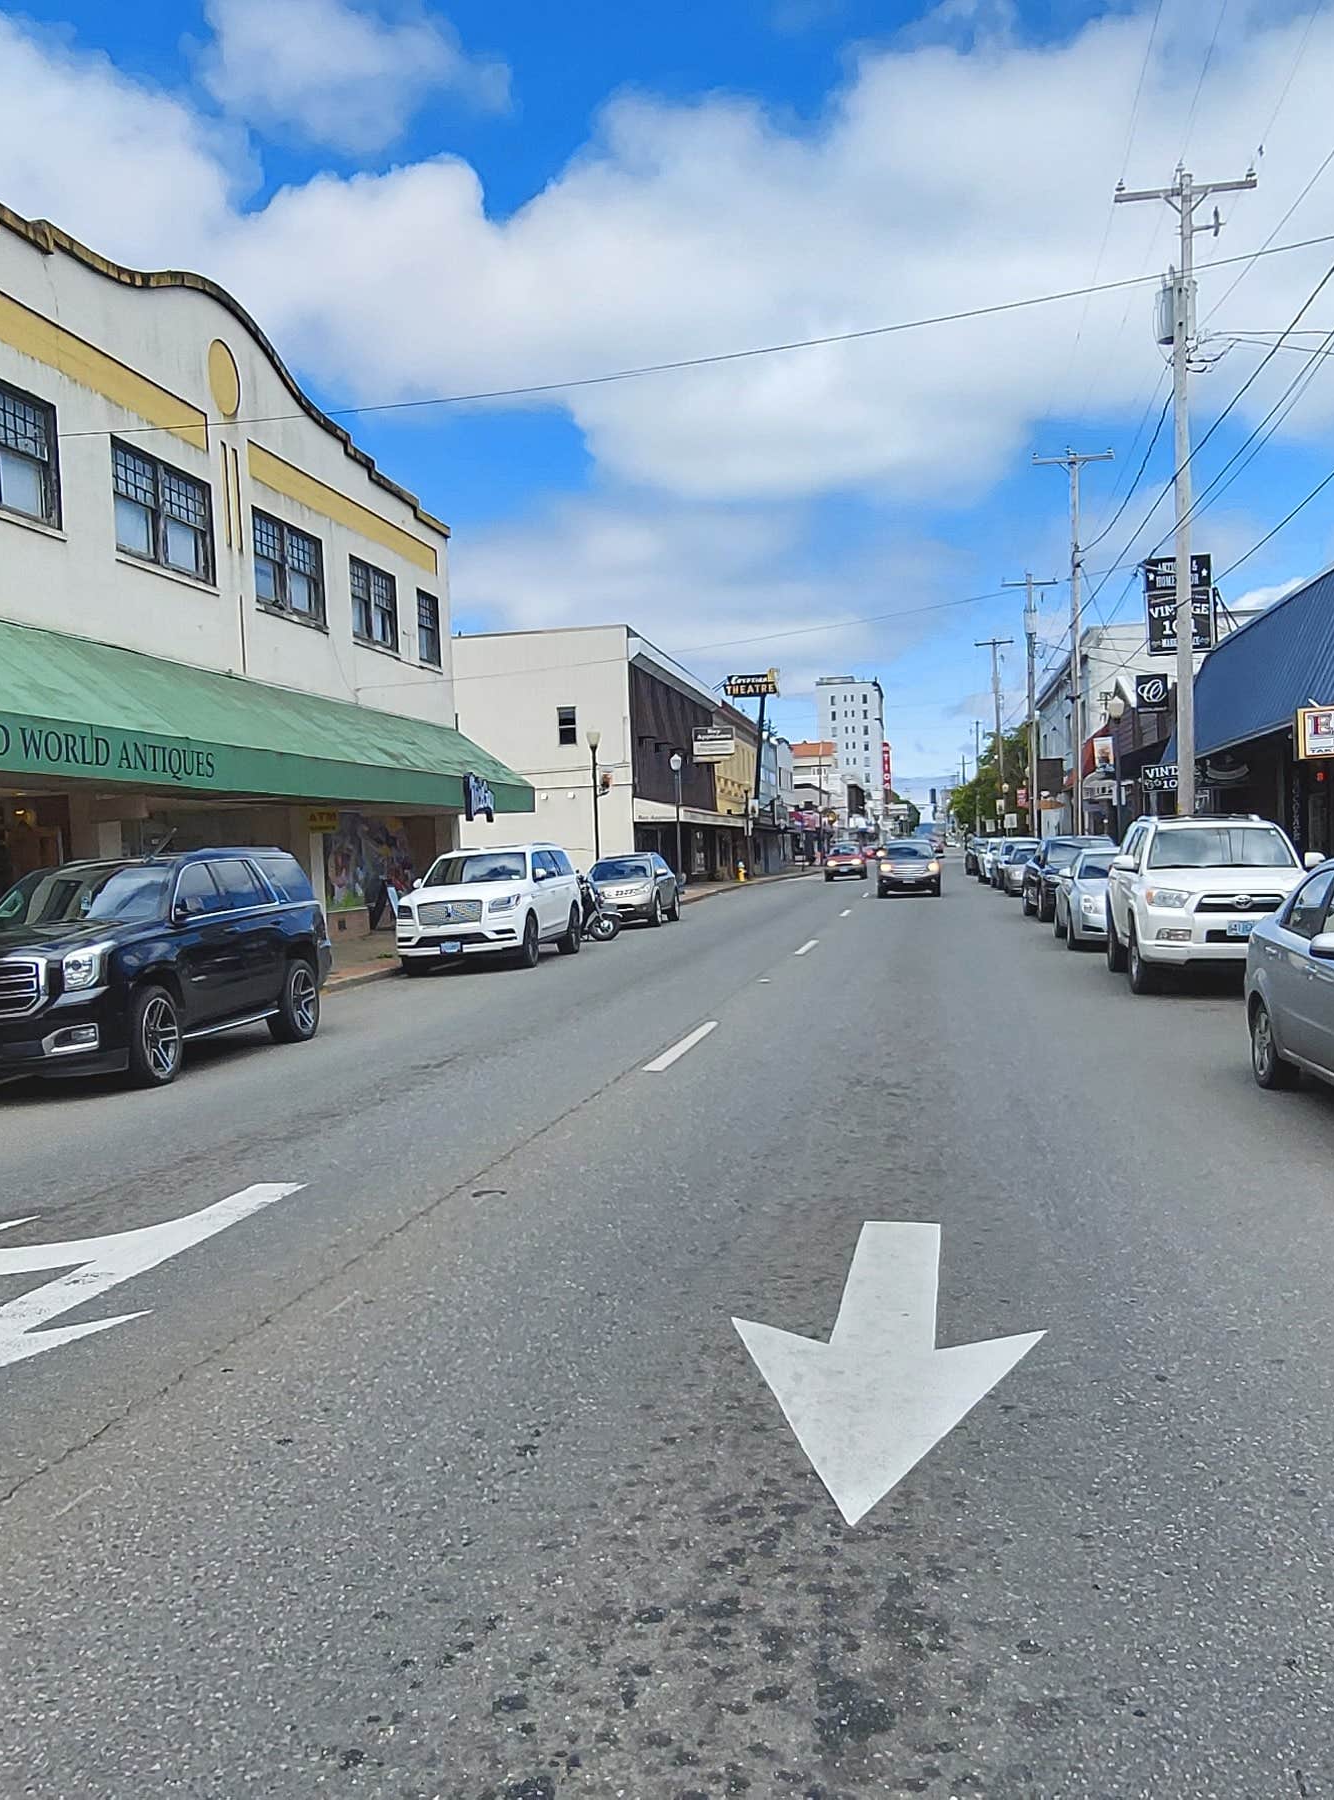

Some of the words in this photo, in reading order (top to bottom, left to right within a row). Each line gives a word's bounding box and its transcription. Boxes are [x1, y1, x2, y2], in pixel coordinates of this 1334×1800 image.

[1149, 603, 1209, 618] VINGE
[726, 684, 774, 695] THEATRE
[19, 727, 110, 766] WORLD
[118, 741, 216, 780] ANTIQUES
